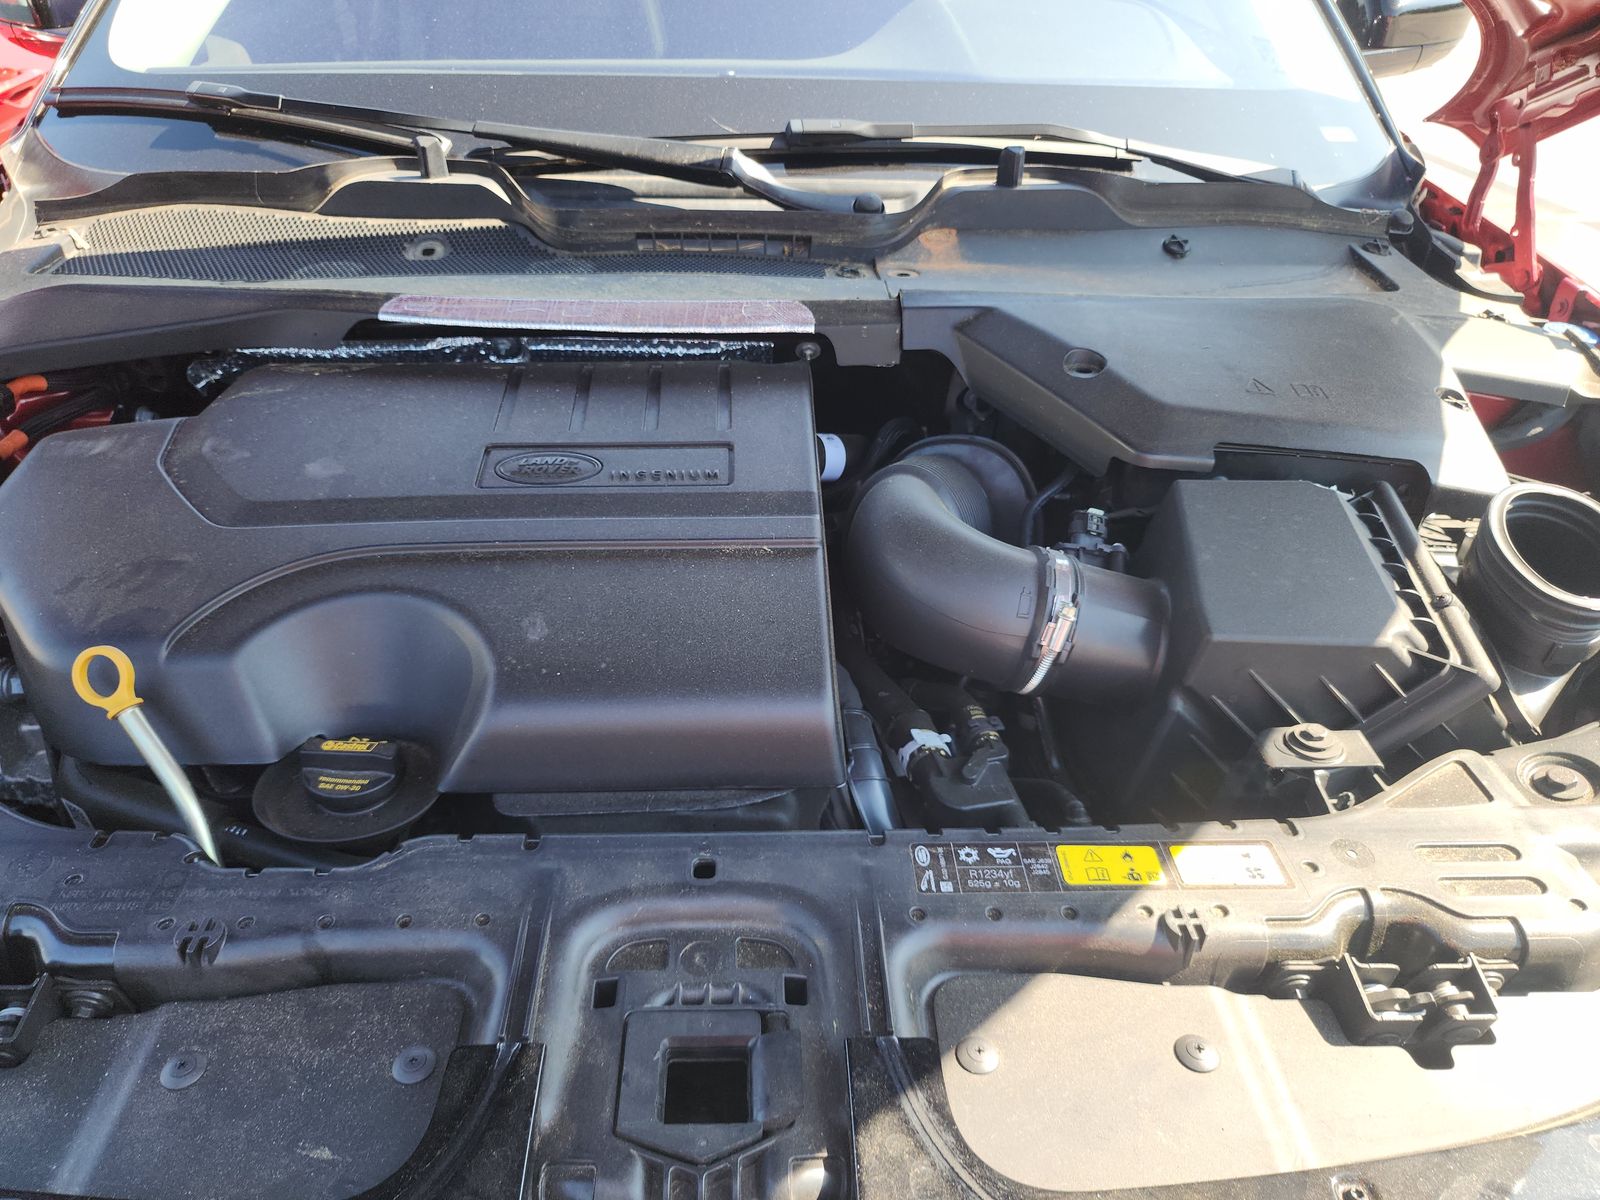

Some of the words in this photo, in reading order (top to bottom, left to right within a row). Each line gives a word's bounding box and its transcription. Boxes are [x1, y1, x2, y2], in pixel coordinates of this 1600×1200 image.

[519, 456, 568, 466] LAND
[518, 465, 581, 475] ROVER
[608, 469, 720, 481] INGENIUM
[333, 741, 370, 750] Castrol
[969, 869, 1013, 880] R1234yf
[1003, 879, 1021, 888] 10g
